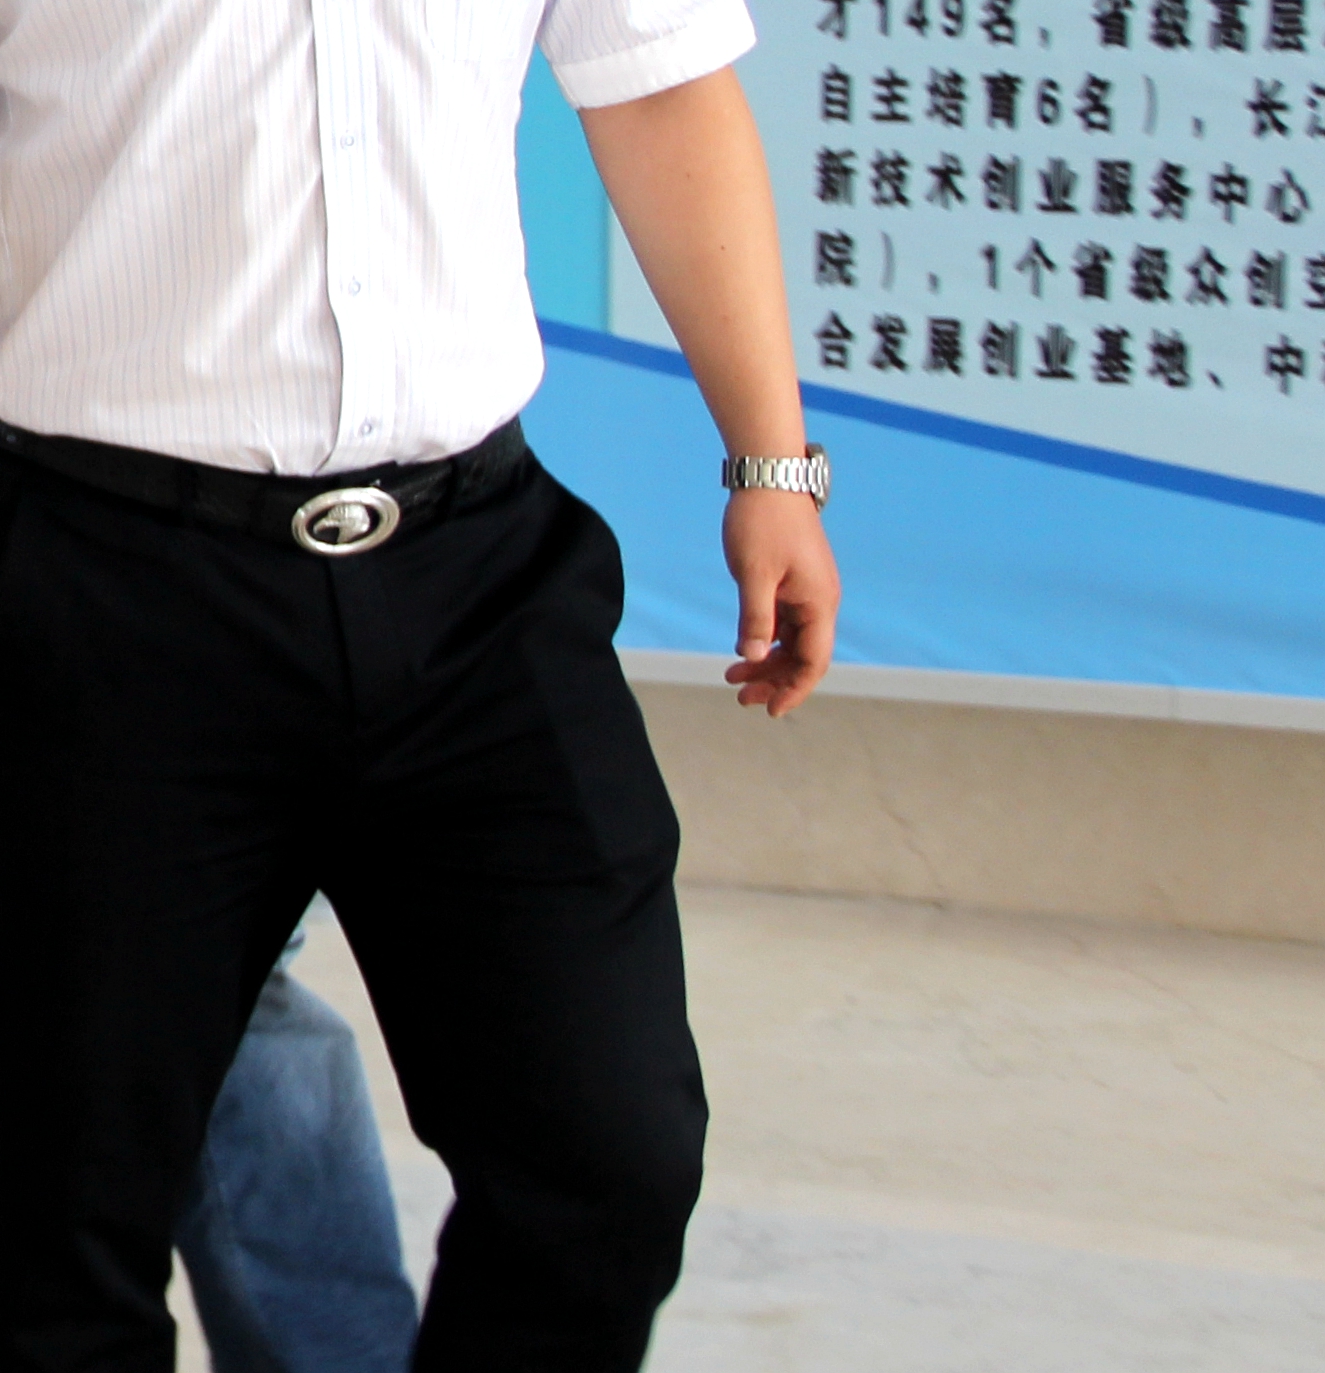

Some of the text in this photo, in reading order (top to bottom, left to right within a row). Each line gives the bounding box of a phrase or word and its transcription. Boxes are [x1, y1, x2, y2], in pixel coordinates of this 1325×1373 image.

[815, 144, 1311, 225] 新技术创业服务中心
[815, 311, 1325, 395] 合发展创业基地、中
